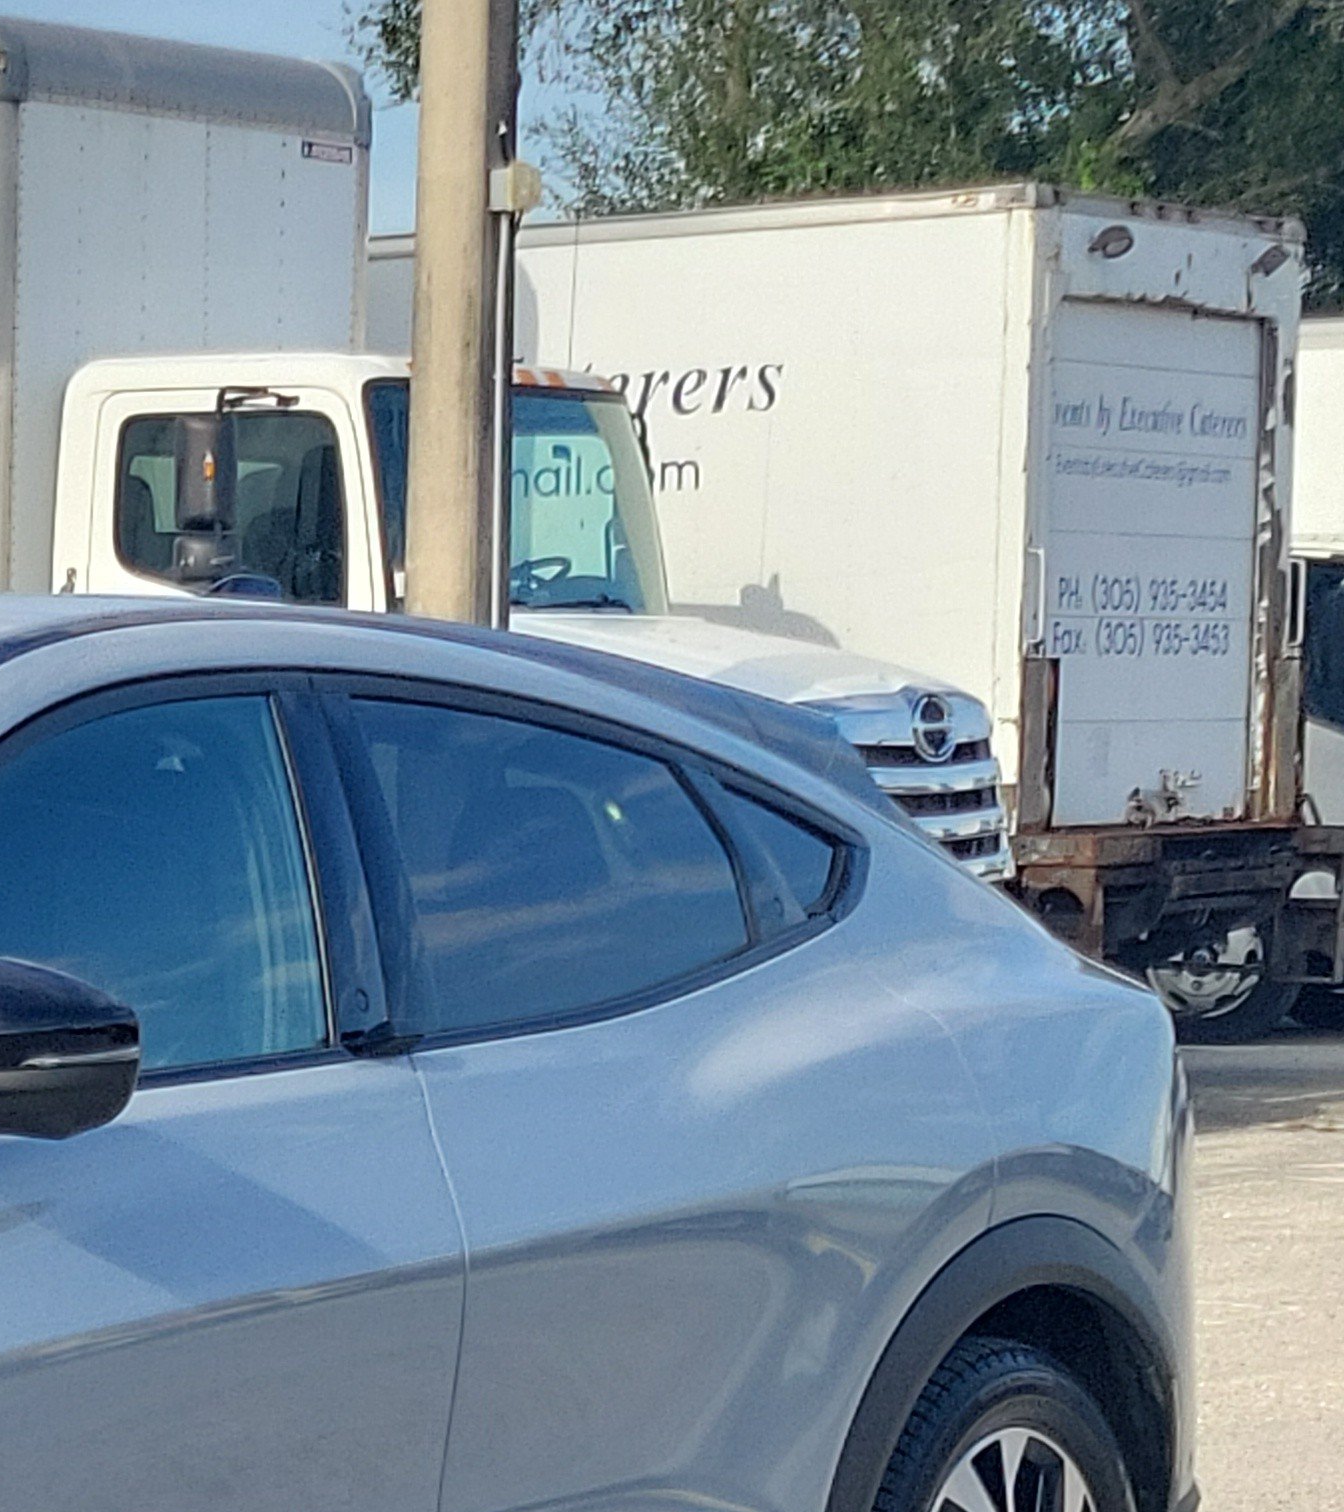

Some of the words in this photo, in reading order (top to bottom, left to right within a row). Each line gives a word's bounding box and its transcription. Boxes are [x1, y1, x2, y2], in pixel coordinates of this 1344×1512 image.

[1091, 572, 1141, 614] (305)
[1149, 578, 1227, 612] 935-3454
[1095, 617, 1145, 658] (305)
[1152, 622, 1230, 656] 935-3453
